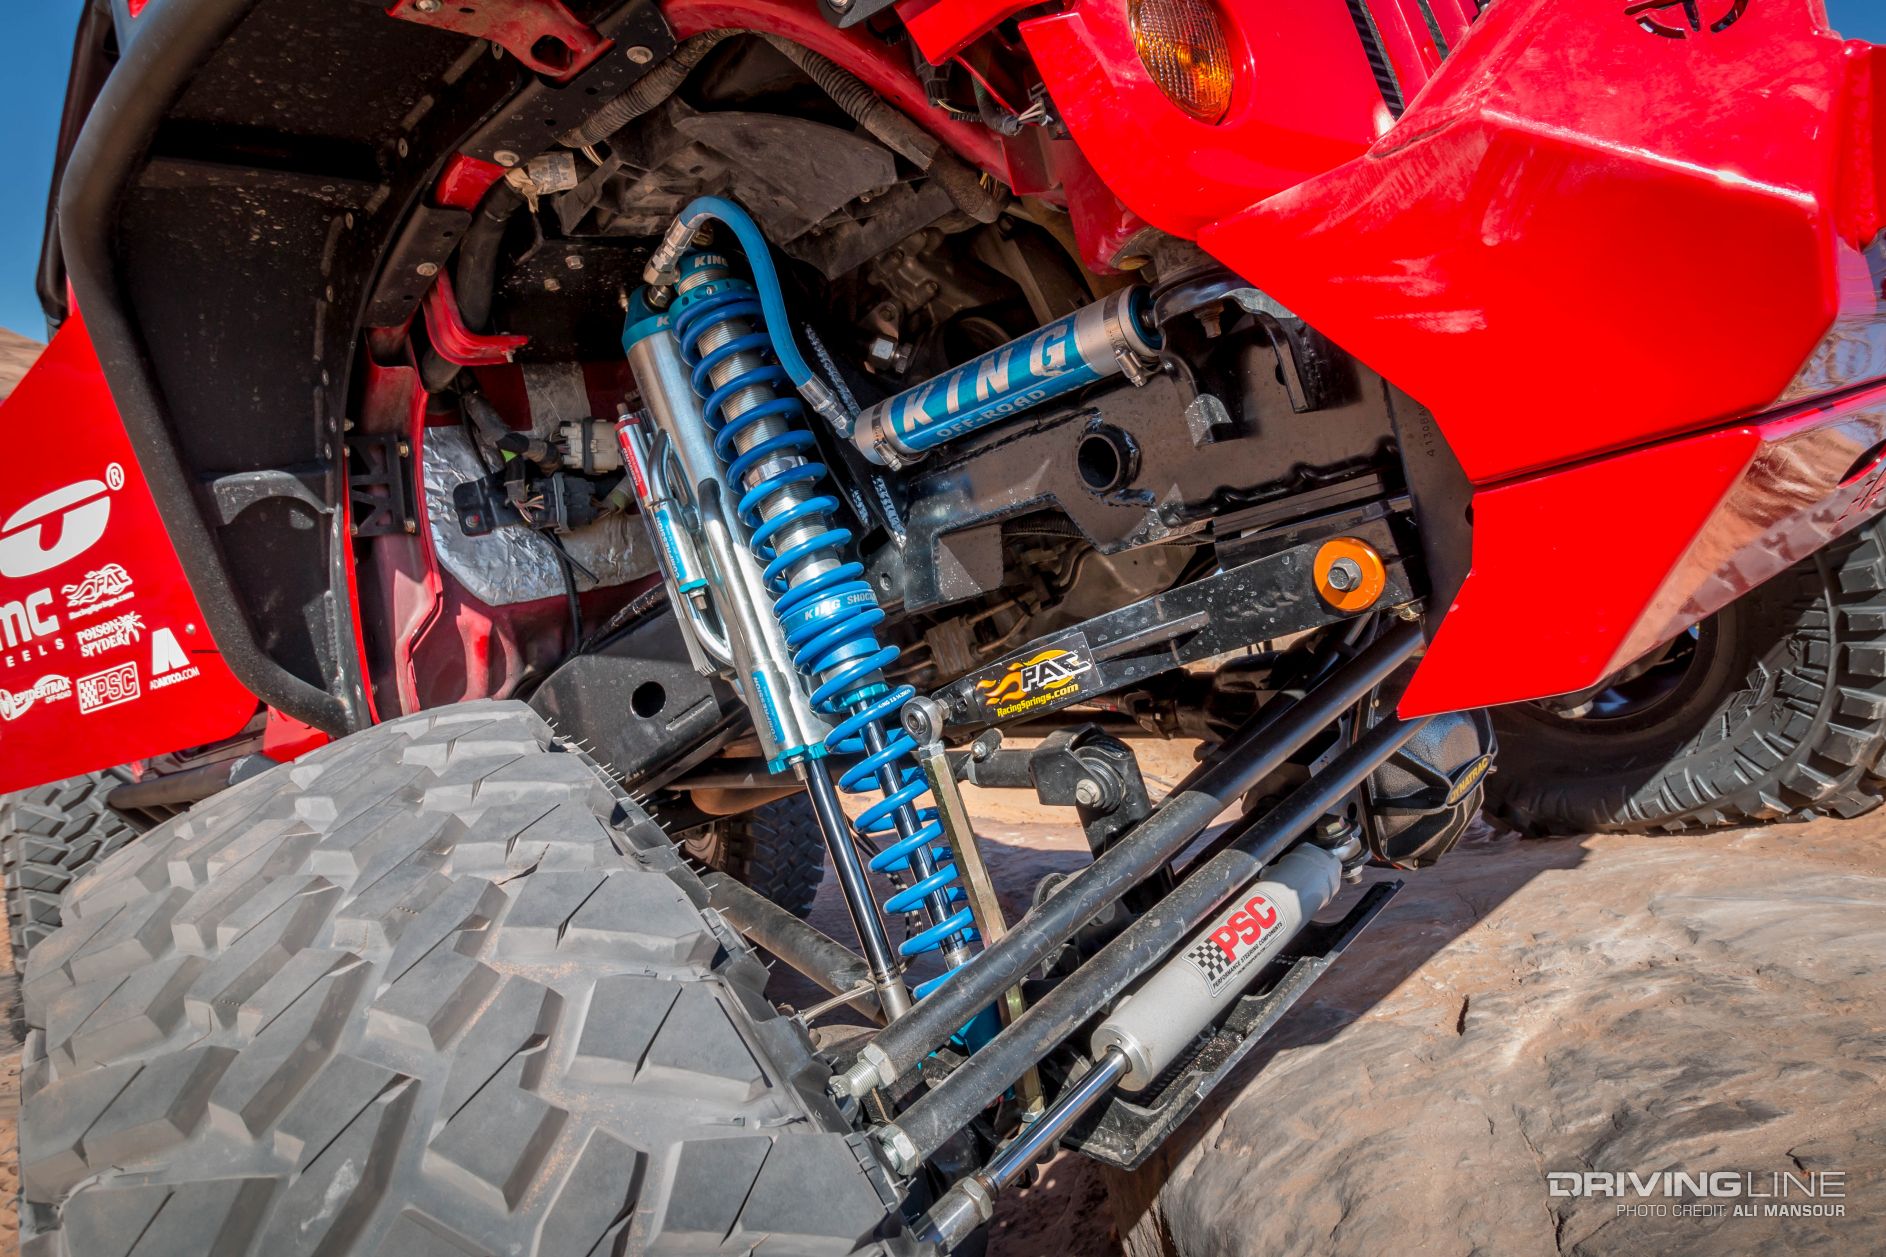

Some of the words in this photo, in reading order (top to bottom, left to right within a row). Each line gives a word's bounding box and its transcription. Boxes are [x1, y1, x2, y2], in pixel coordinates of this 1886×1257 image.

[903, 323, 1068, 432] KING
[936, 389, 1046, 439] OFF-ROAD
[94, 569, 133, 595] PAC
[804, 600, 841, 621] KING
[76, 619, 121, 645] POISON
[81, 631, 130, 658] SPYDER
[97, 667, 138, 703] PSC
[1021, 651, 1092, 693] PAC
[997, 683, 1079, 717] RacingSprings.com
[1448, 757, 1488, 803] DYNATRAC
[1208, 896, 1277, 964] PSC
[1212, 961, 1241, 989] PERFORMANCE
[1241, 944, 1259, 962] STEERING
[1259, 922, 1283, 946] COMPONENTS
